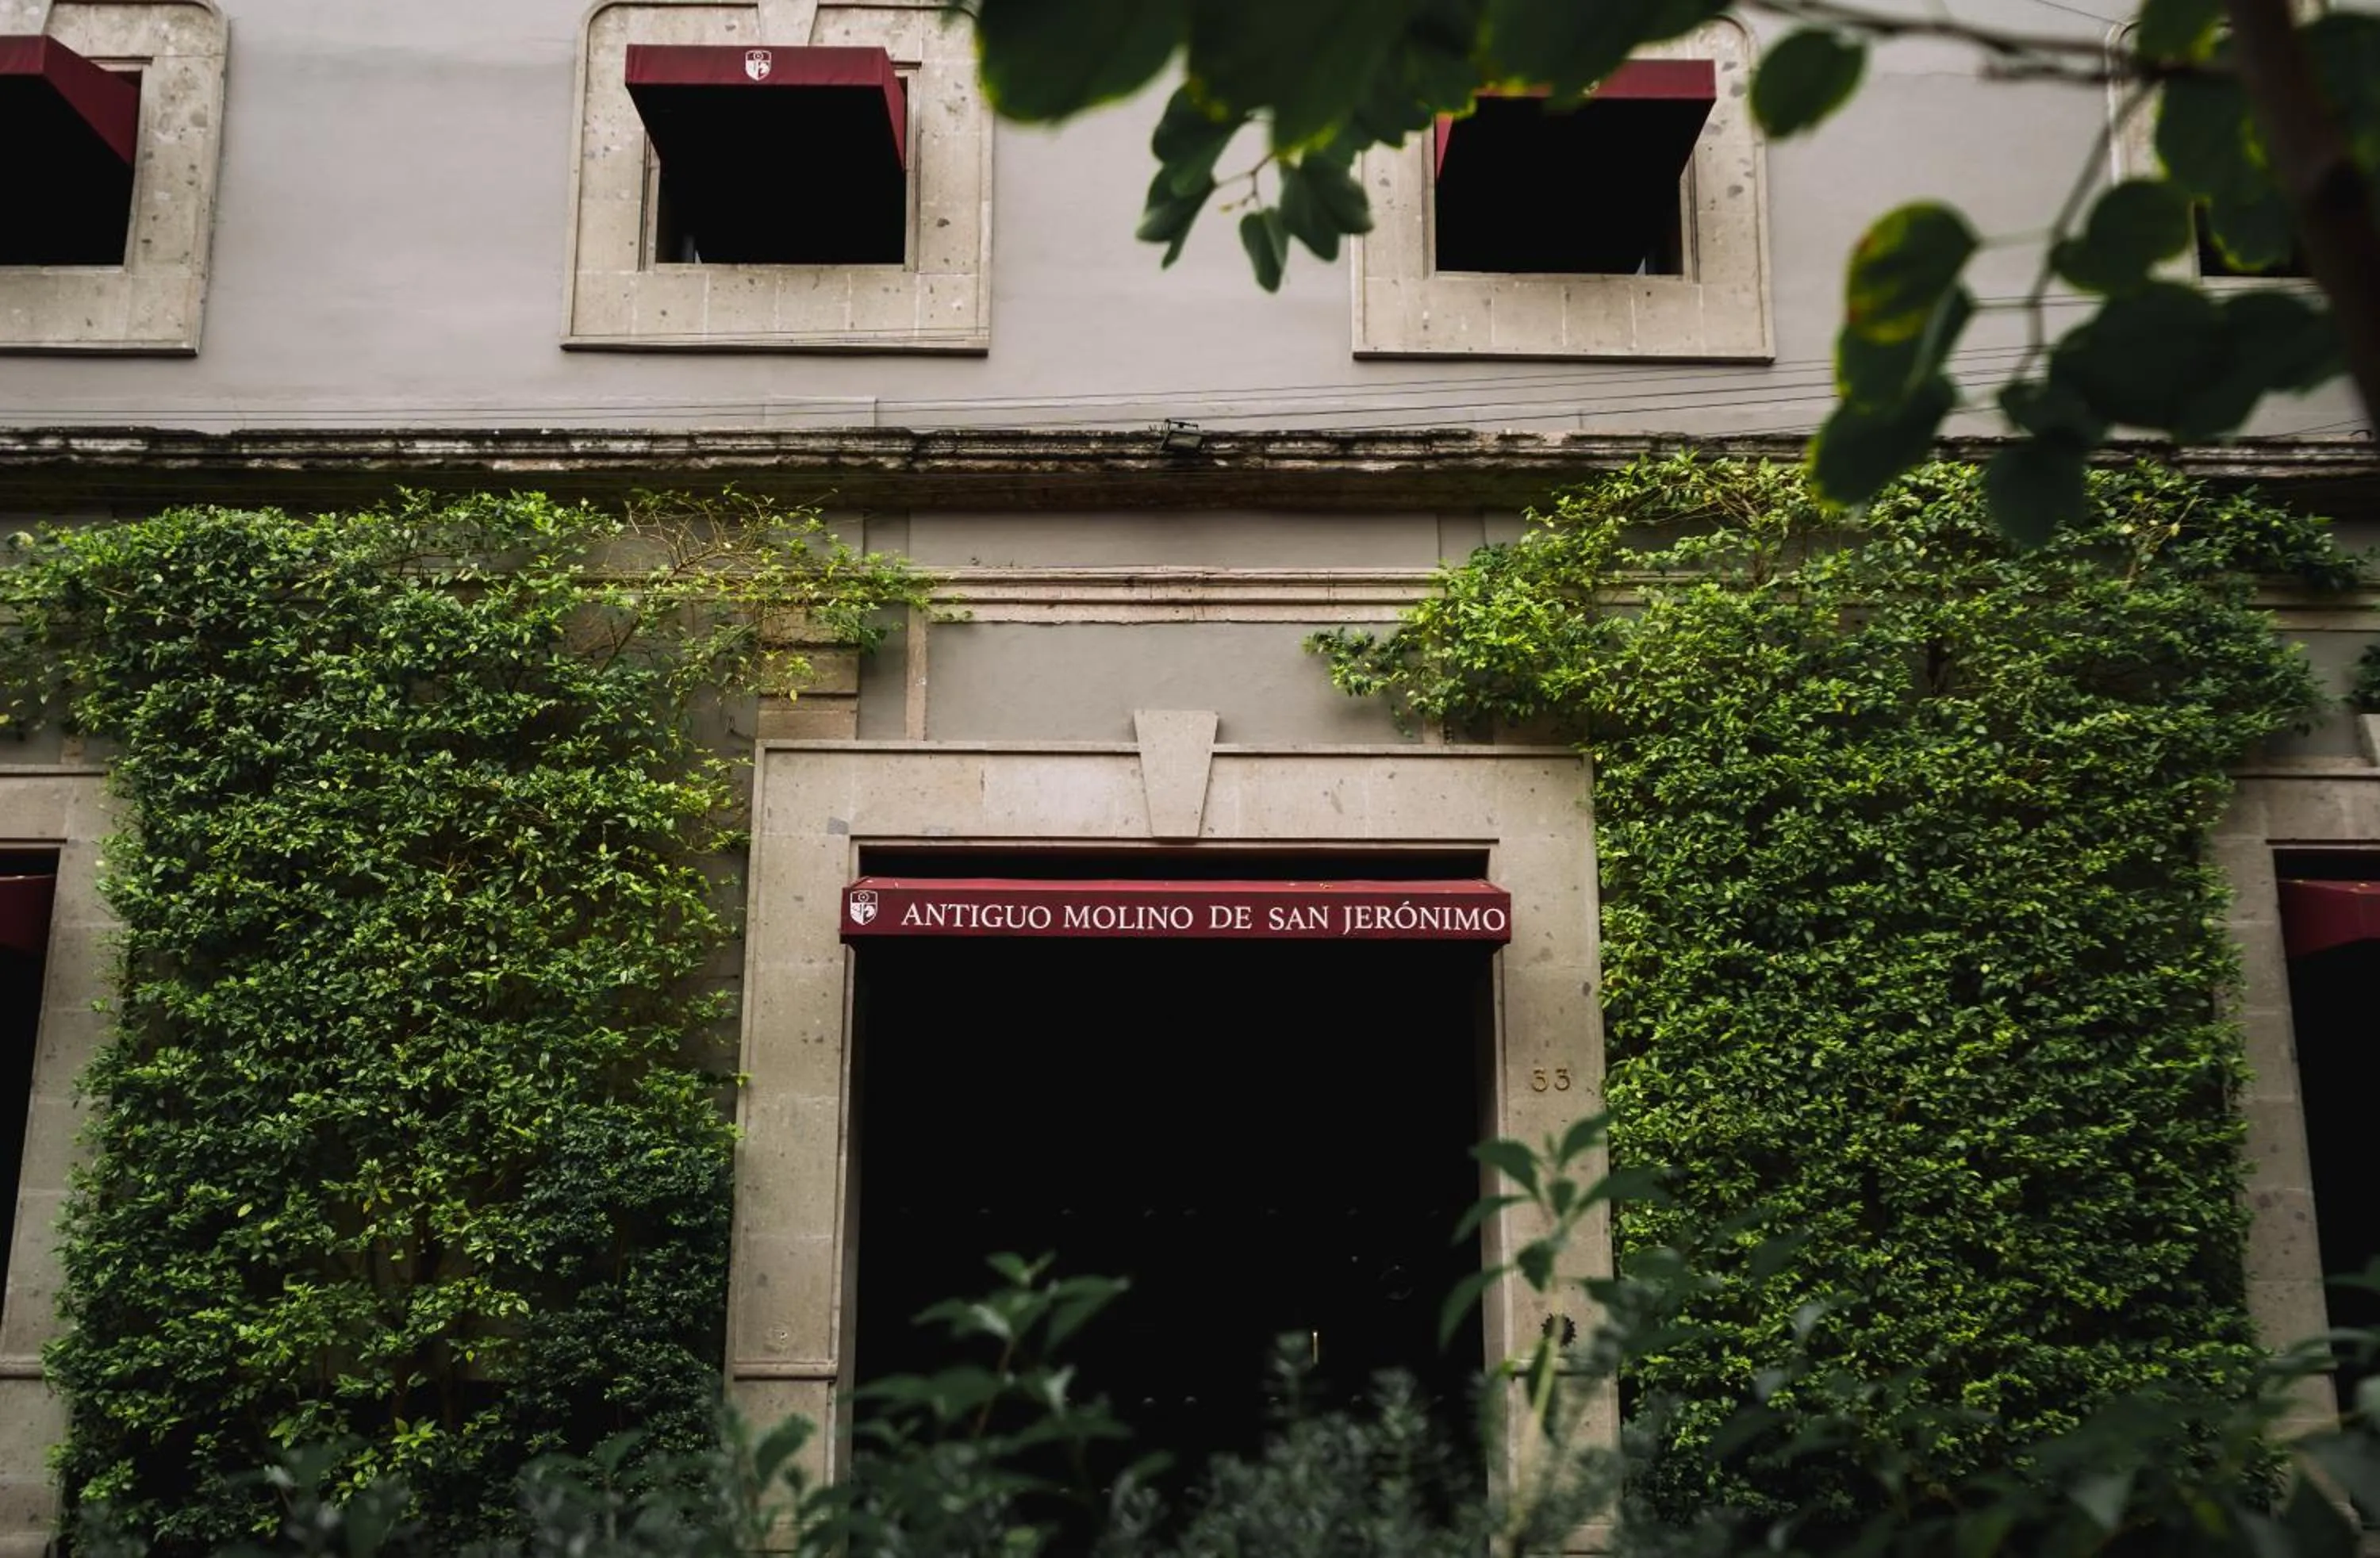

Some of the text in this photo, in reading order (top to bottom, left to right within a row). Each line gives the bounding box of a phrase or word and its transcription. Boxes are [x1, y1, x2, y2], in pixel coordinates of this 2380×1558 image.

[900, 900, 1506, 935] ANTIGUO MOLINO DE SAN JERÓNIMO
[1530, 1067, 1571, 1092] 33
